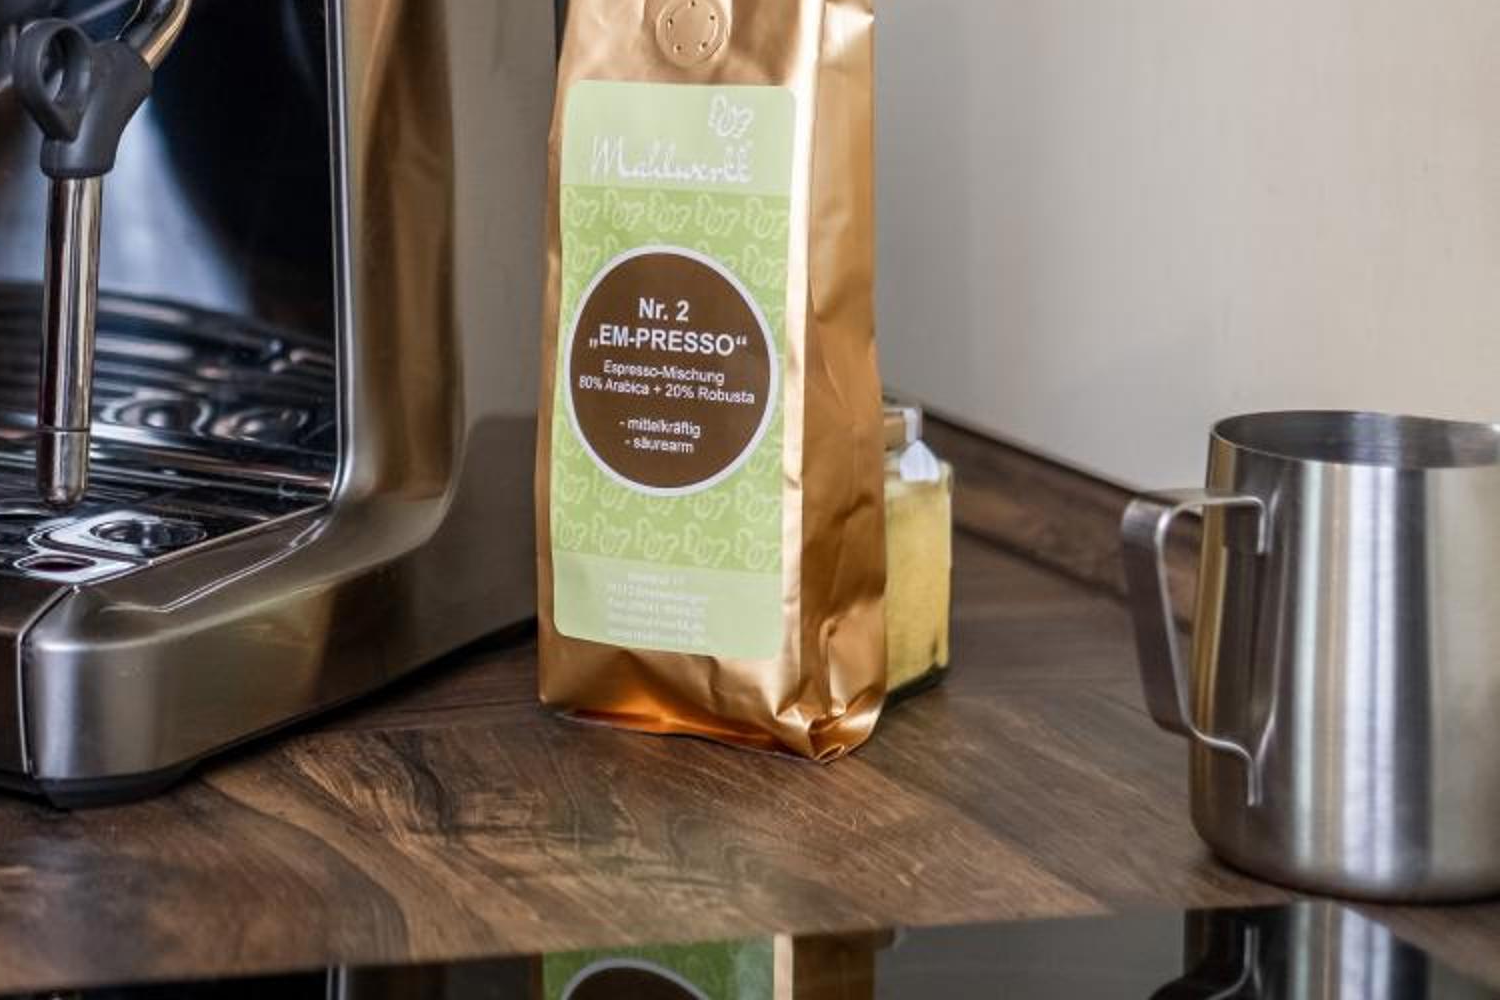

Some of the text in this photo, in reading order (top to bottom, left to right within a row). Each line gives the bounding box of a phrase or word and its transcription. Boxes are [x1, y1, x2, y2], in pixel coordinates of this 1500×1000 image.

[638, 297, 690, 322] Nr. 2
[603, 359, 725, 387] Espresso-Mischung
[603, 377, 650, 396] Arabica
[653, 384, 662, 395] +
[665, 383, 695, 399] 20%
[697, 386, 756, 404] Robusta
[627, 416, 701, 439] mittelkräftig
